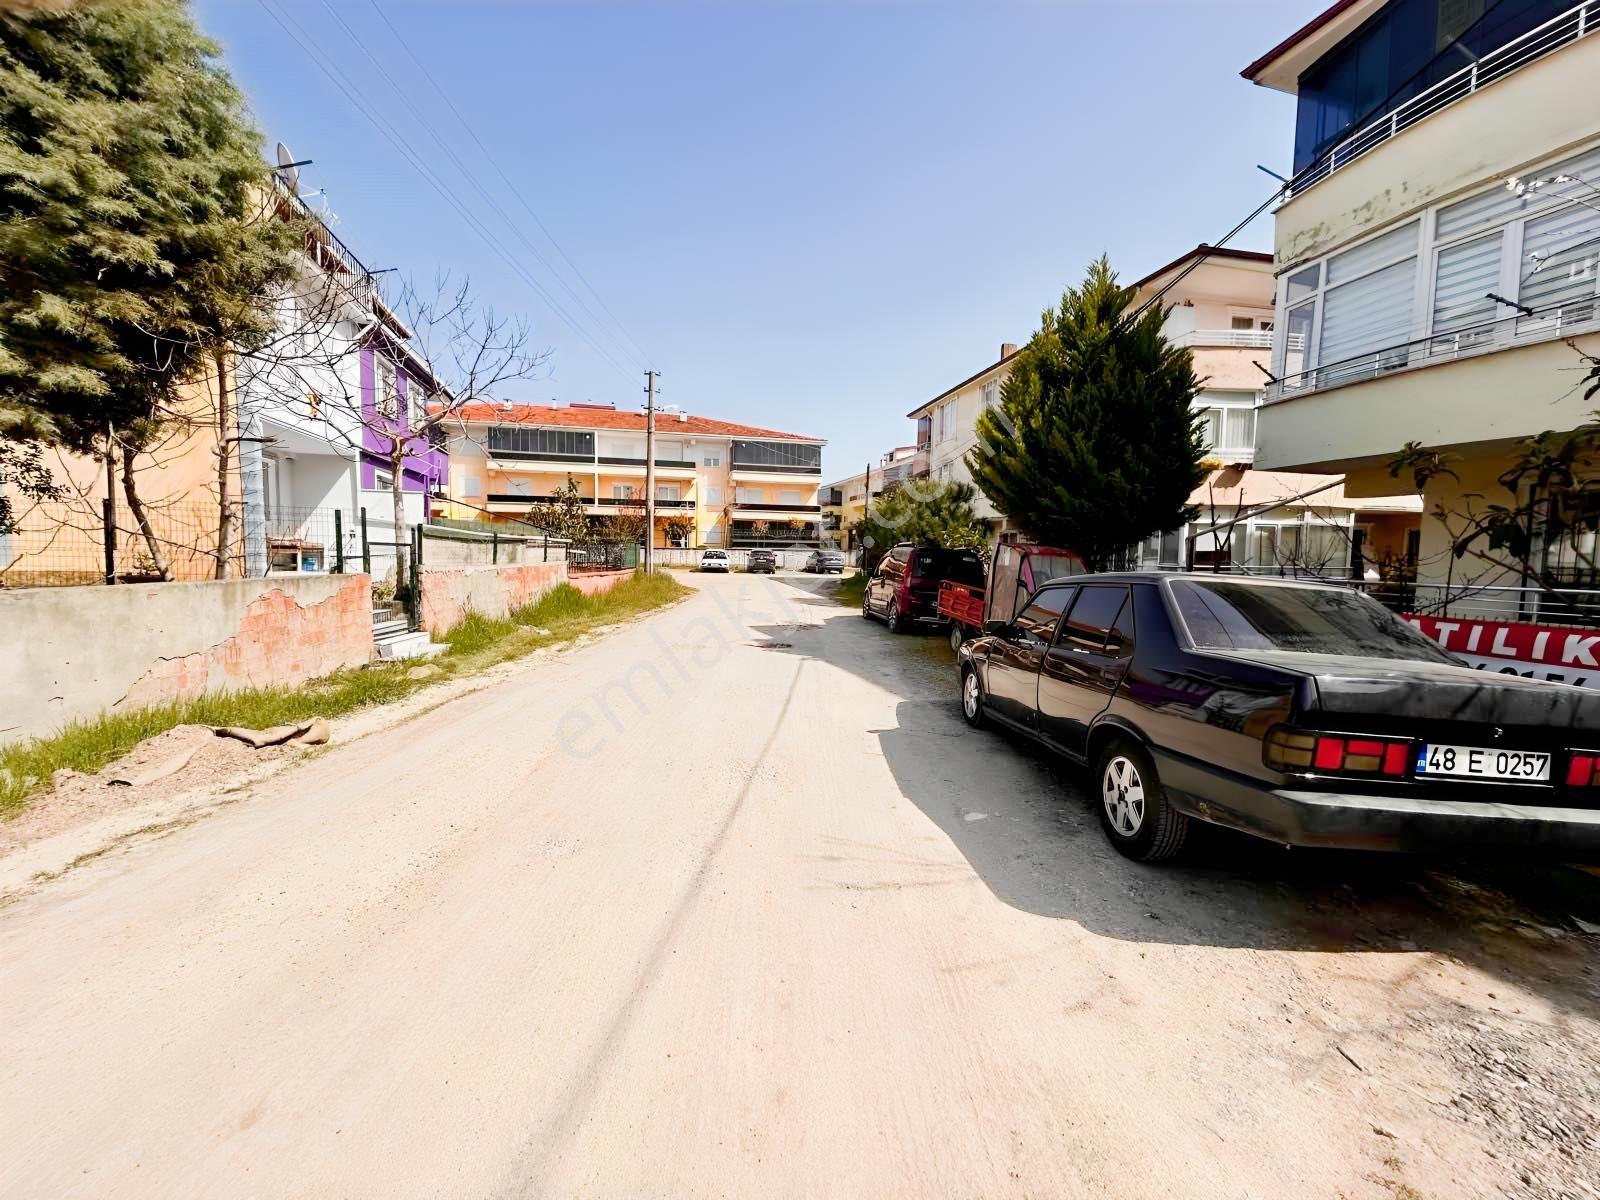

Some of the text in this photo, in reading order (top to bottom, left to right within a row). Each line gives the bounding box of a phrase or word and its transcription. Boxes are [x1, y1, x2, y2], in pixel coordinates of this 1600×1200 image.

[1428, 746, 1549, 777] 48 E 0257
